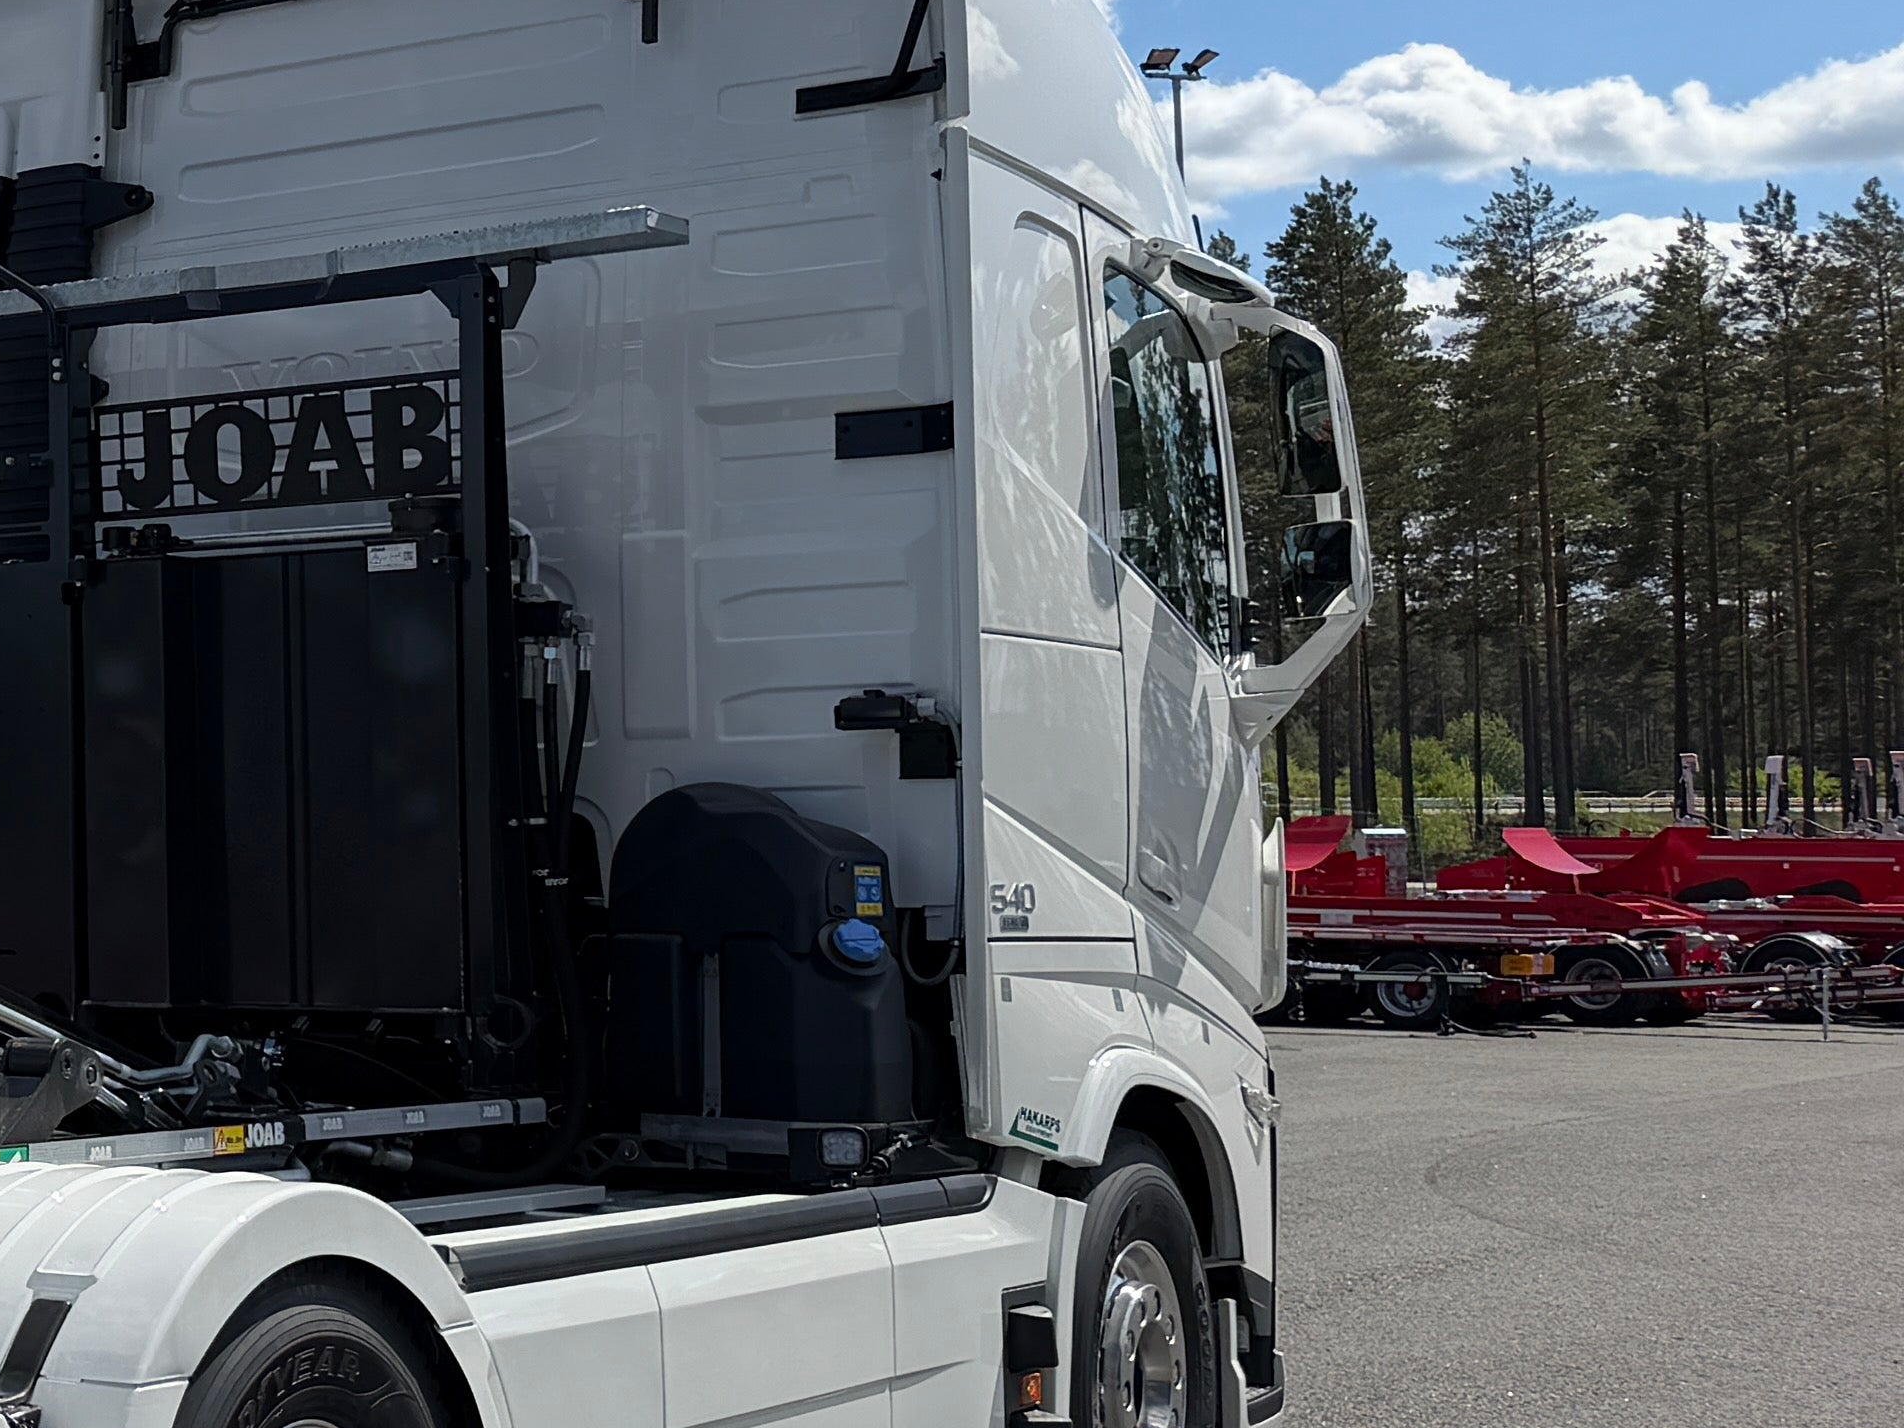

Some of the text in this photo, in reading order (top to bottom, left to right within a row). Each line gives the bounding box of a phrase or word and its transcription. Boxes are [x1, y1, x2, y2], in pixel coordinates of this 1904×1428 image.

[117, 384, 452, 510] JOAB
[989, 883, 1036, 914] 540
[245, 1121, 285, 1148] JOAB
